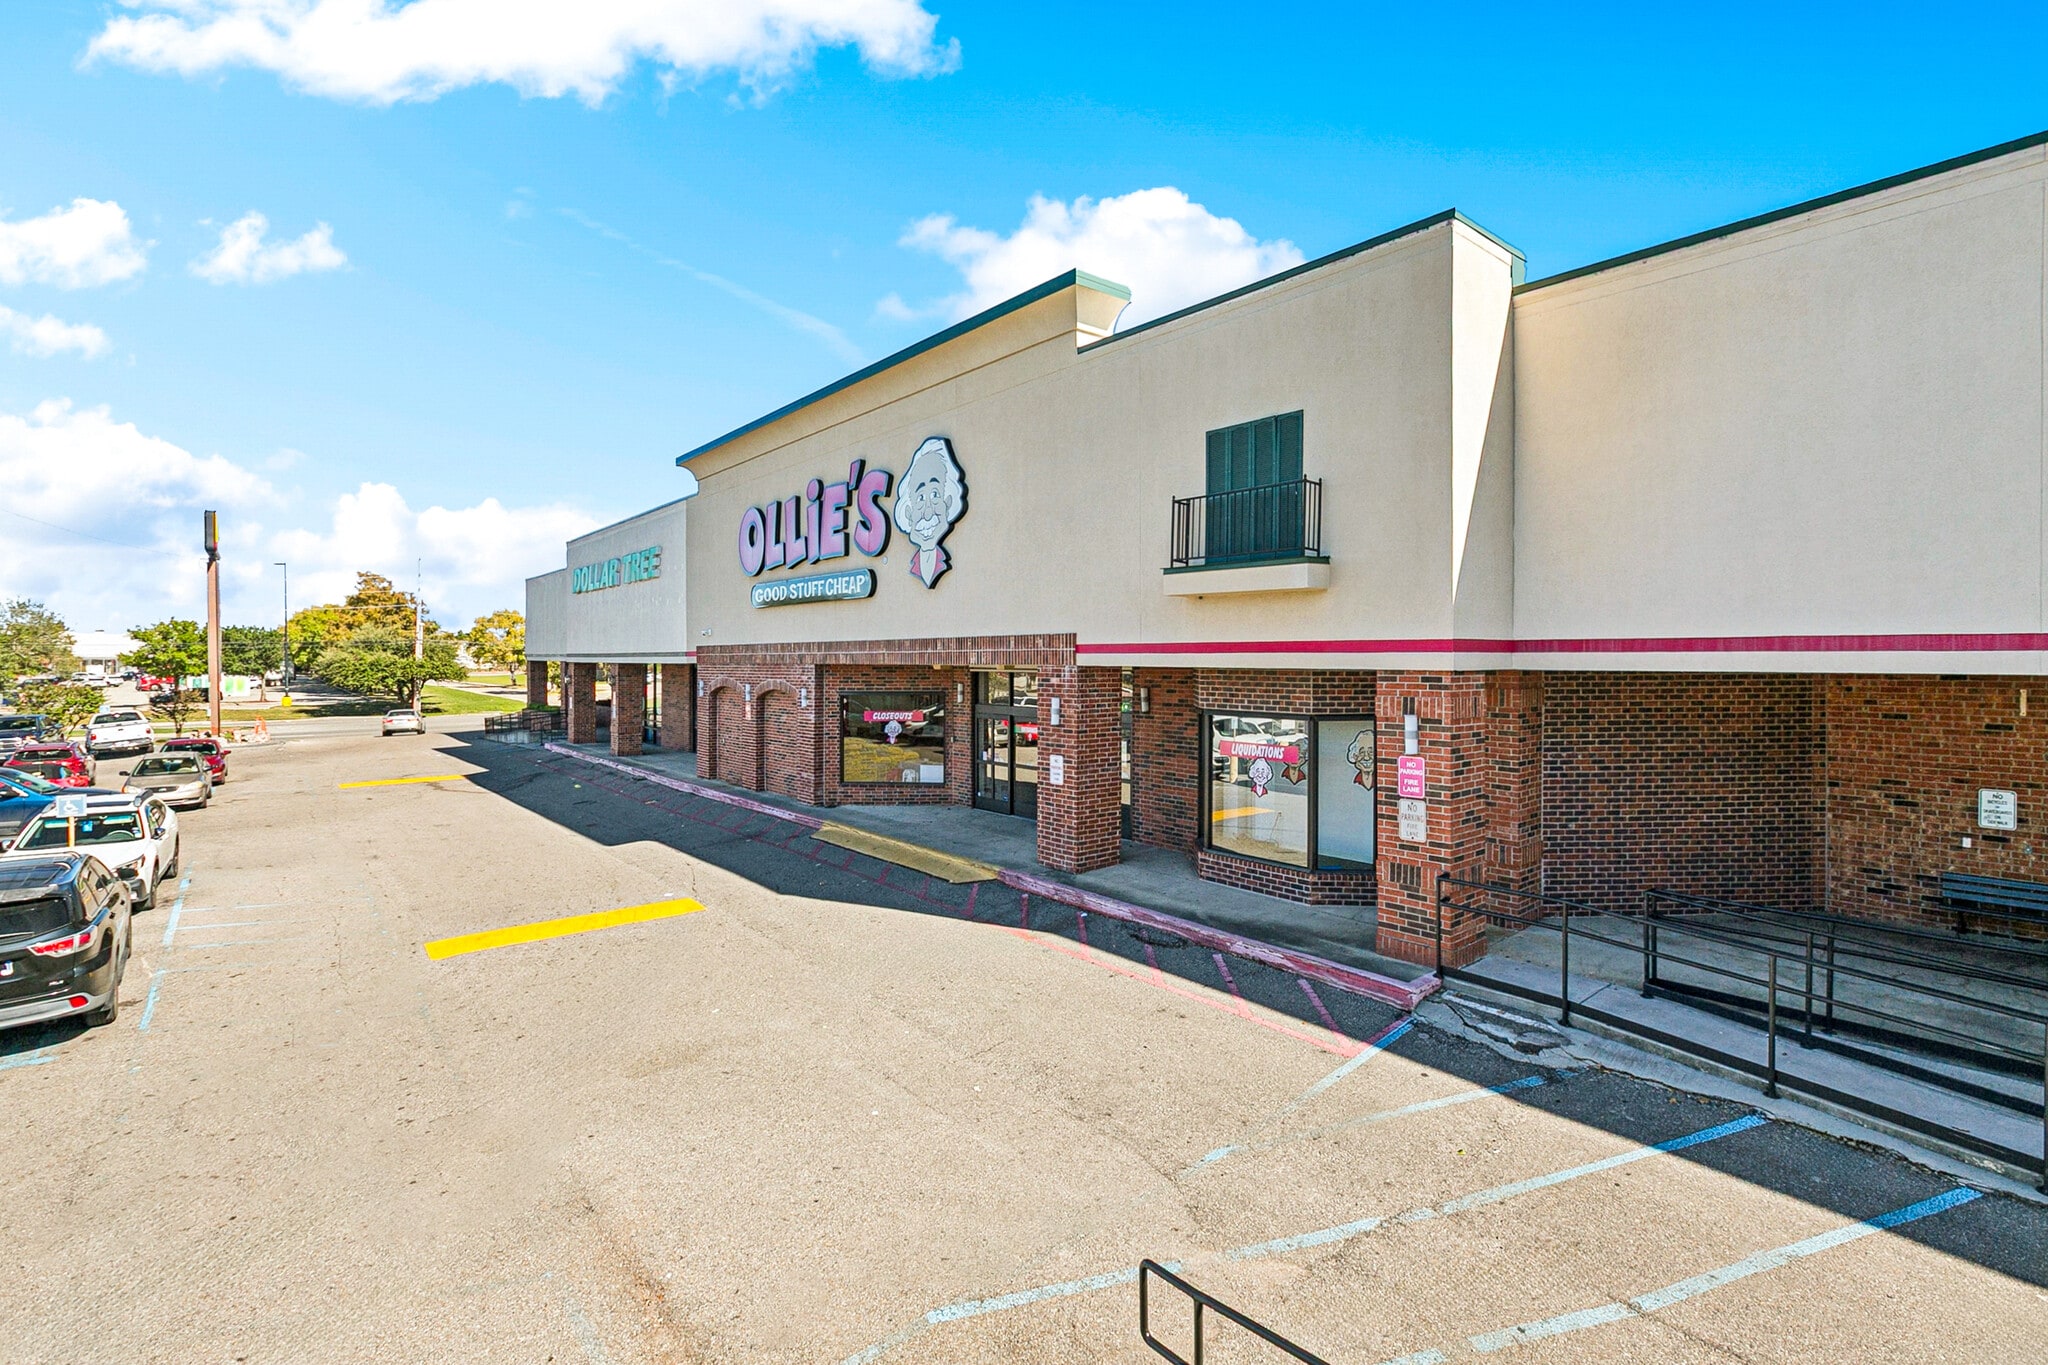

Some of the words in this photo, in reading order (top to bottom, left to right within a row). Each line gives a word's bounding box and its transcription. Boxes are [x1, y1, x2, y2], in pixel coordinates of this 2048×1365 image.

[572, 558, 621, 594] DOLLAR
[622, 546, 662, 584] TREE
[755, 586, 787, 603] GOOD
[789, 580, 824, 599] STUFF
[825, 575, 866, 596] CHEAP
[872, 711, 914, 720] CLOSEOUTS
[1231, 743, 1284, 759] LIQUIDATIONS
[1400, 768, 1423, 776] PARKING
[1401, 813, 1424, 822] PARKING
